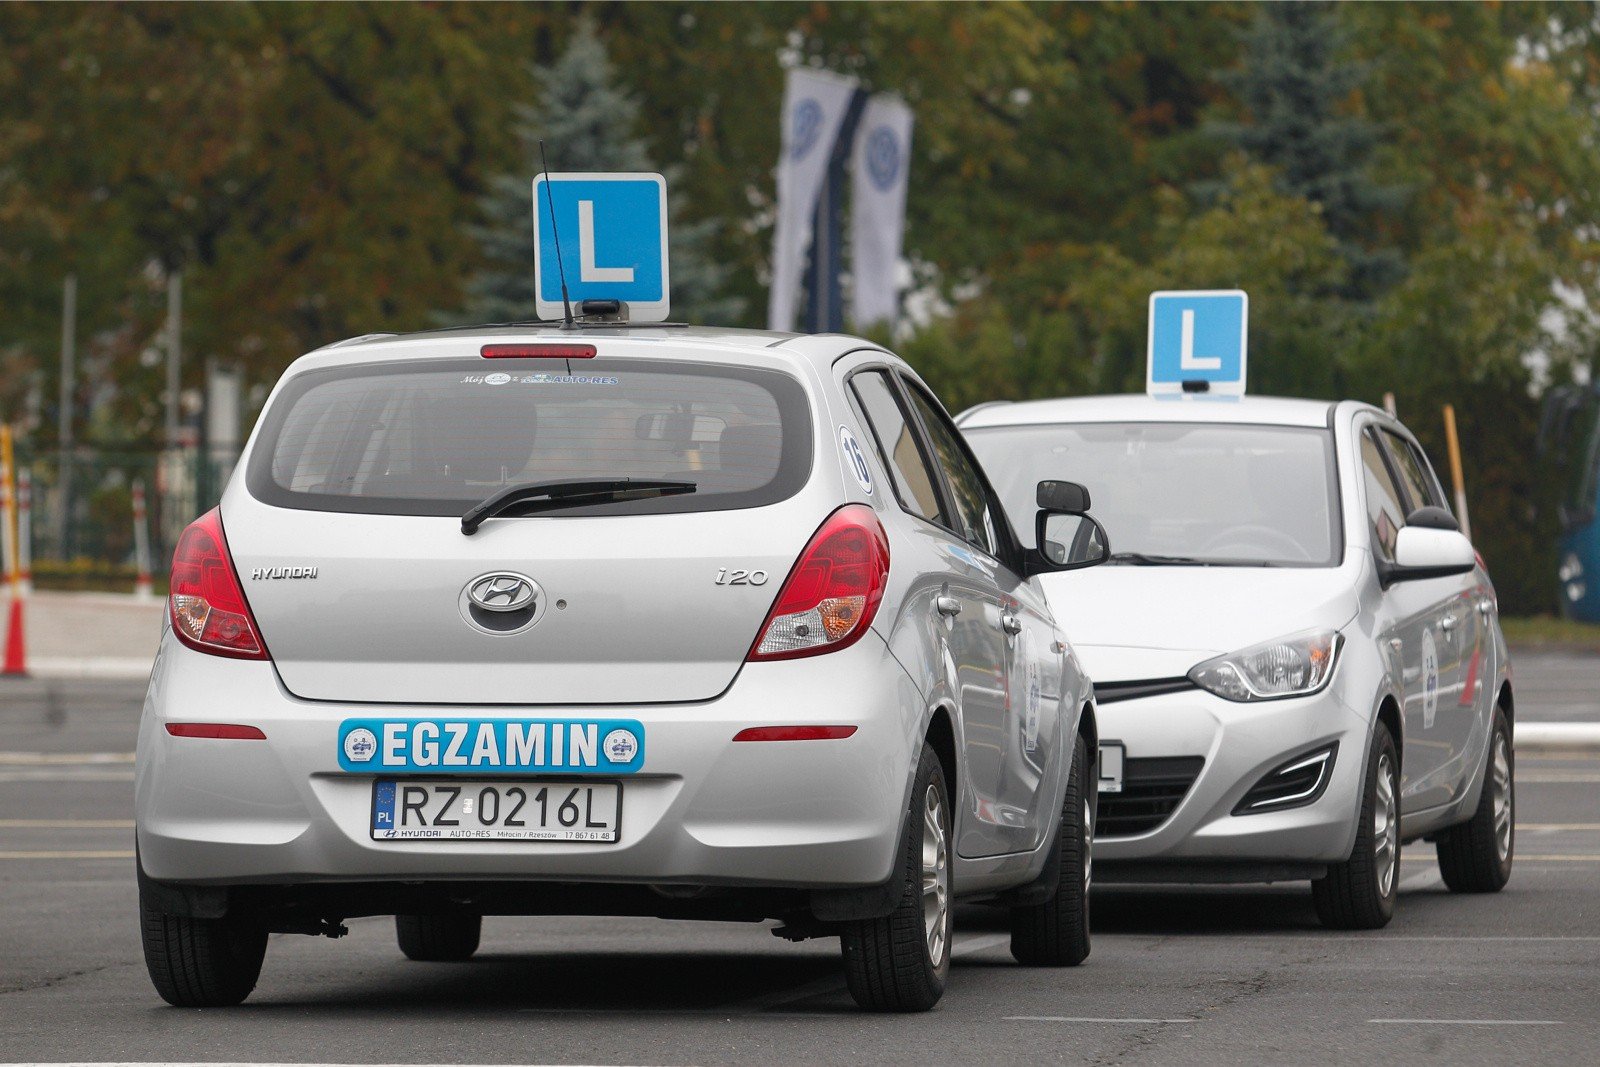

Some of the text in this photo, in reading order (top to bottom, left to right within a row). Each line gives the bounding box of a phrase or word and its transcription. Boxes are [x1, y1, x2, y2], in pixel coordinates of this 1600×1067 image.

[578, 200, 634, 282] L
[1181, 309, 1222, 370] L
[460, 376, 483, 385] Mój
[550, 375, 619, 385] AUTO-RES
[843, 437, 870, 484] 16
[252, 566, 318, 580] HYUNDAI
[715, 567, 769, 586] i20
[382, 721, 599, 767] EGZAMIN
[377, 812, 392, 823] PL
[401, 786, 607, 828] RZ 0216L
[449, 830, 491, 838] AUTO-RES
[528, 831, 558, 839] Rzeszów
